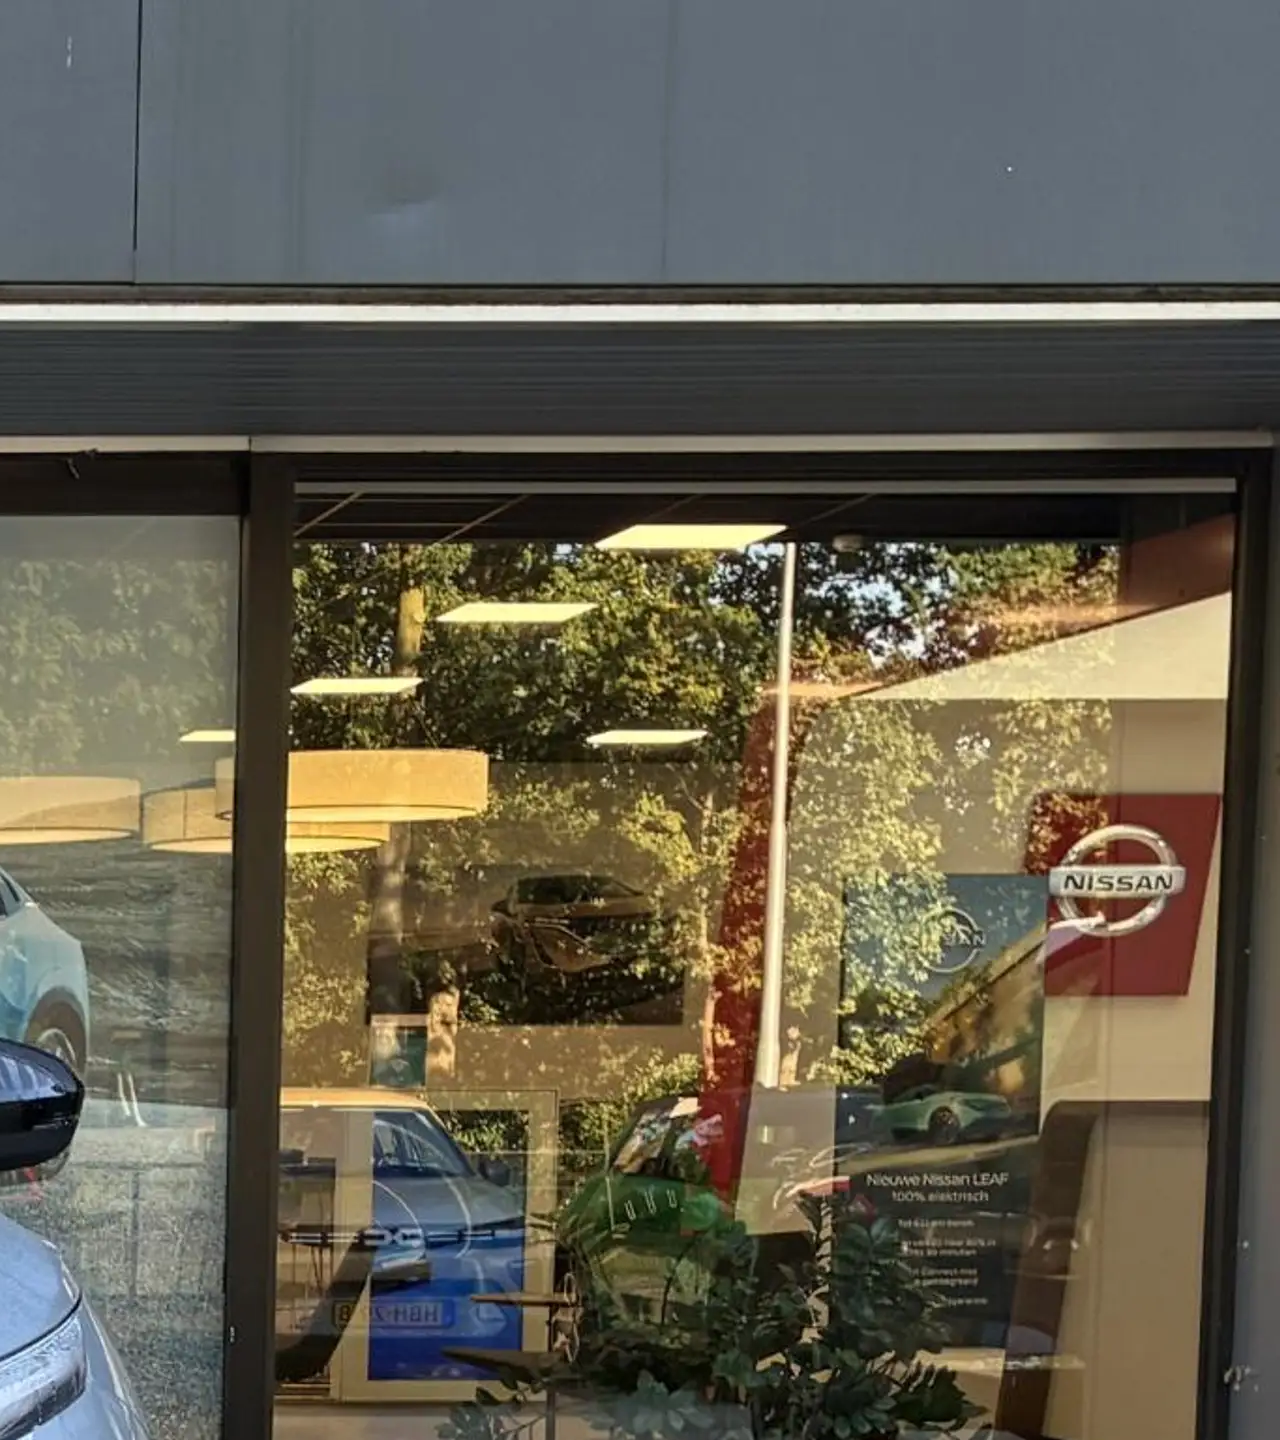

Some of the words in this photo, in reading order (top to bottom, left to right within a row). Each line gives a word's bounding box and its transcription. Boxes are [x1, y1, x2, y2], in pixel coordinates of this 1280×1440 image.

[1063, 874, 1173, 892] NISSAN
[866, 1173, 920, 1187] Nieuwe
[922, 1172, 971, 1187] Nissan
[973, 1171, 1010, 1187] LEAF
[892, 1190, 927, 1202] 100%
